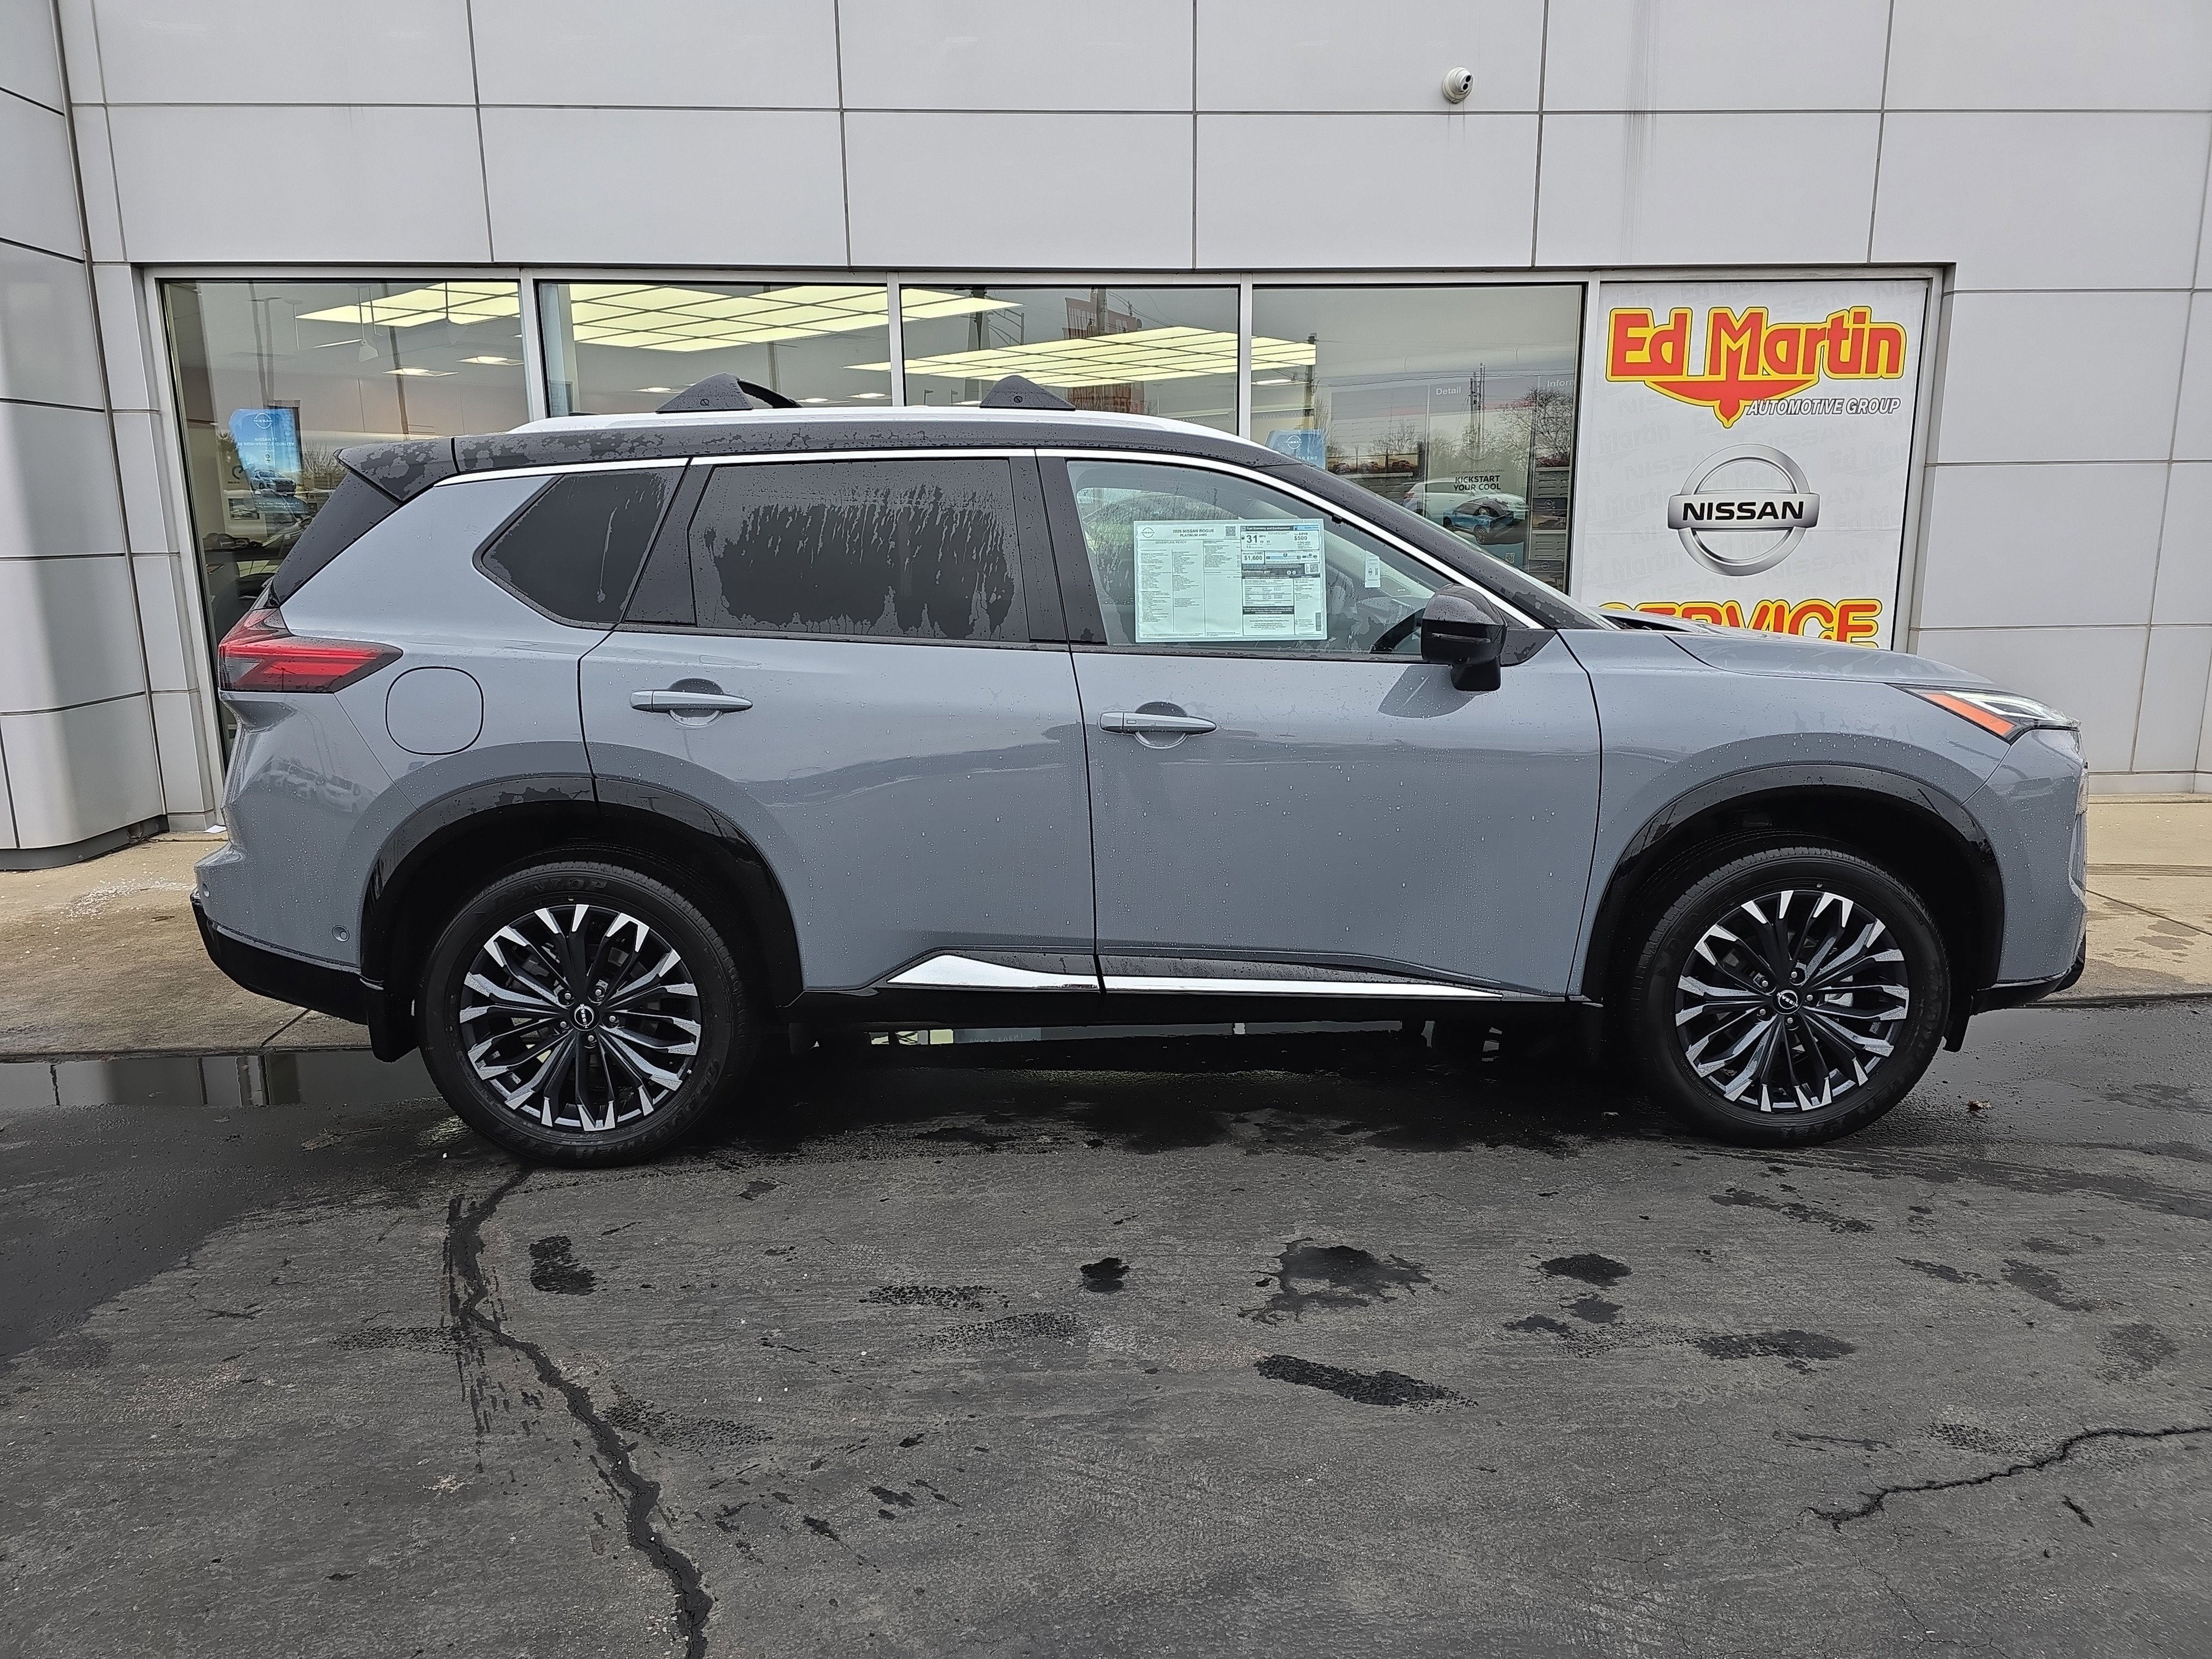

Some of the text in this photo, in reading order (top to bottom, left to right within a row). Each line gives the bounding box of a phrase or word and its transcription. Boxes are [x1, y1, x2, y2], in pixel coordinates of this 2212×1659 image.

[1606, 306, 1906, 381] Ed Martin
[1436, 387, 1461, 395] Detail
[1746, 397, 1901, 416] AUTOMOTIVE GROUP
[1455, 475, 1500, 484] KICKSTART
[1682, 501, 1804, 522] NISSAN
[1246, 535, 1257, 543] 31
[1598, 599, 1883, 648] VICE
[1777, 992, 1798, 1007] NISSAN
[580, 1004, 589, 1028] NISSAN
